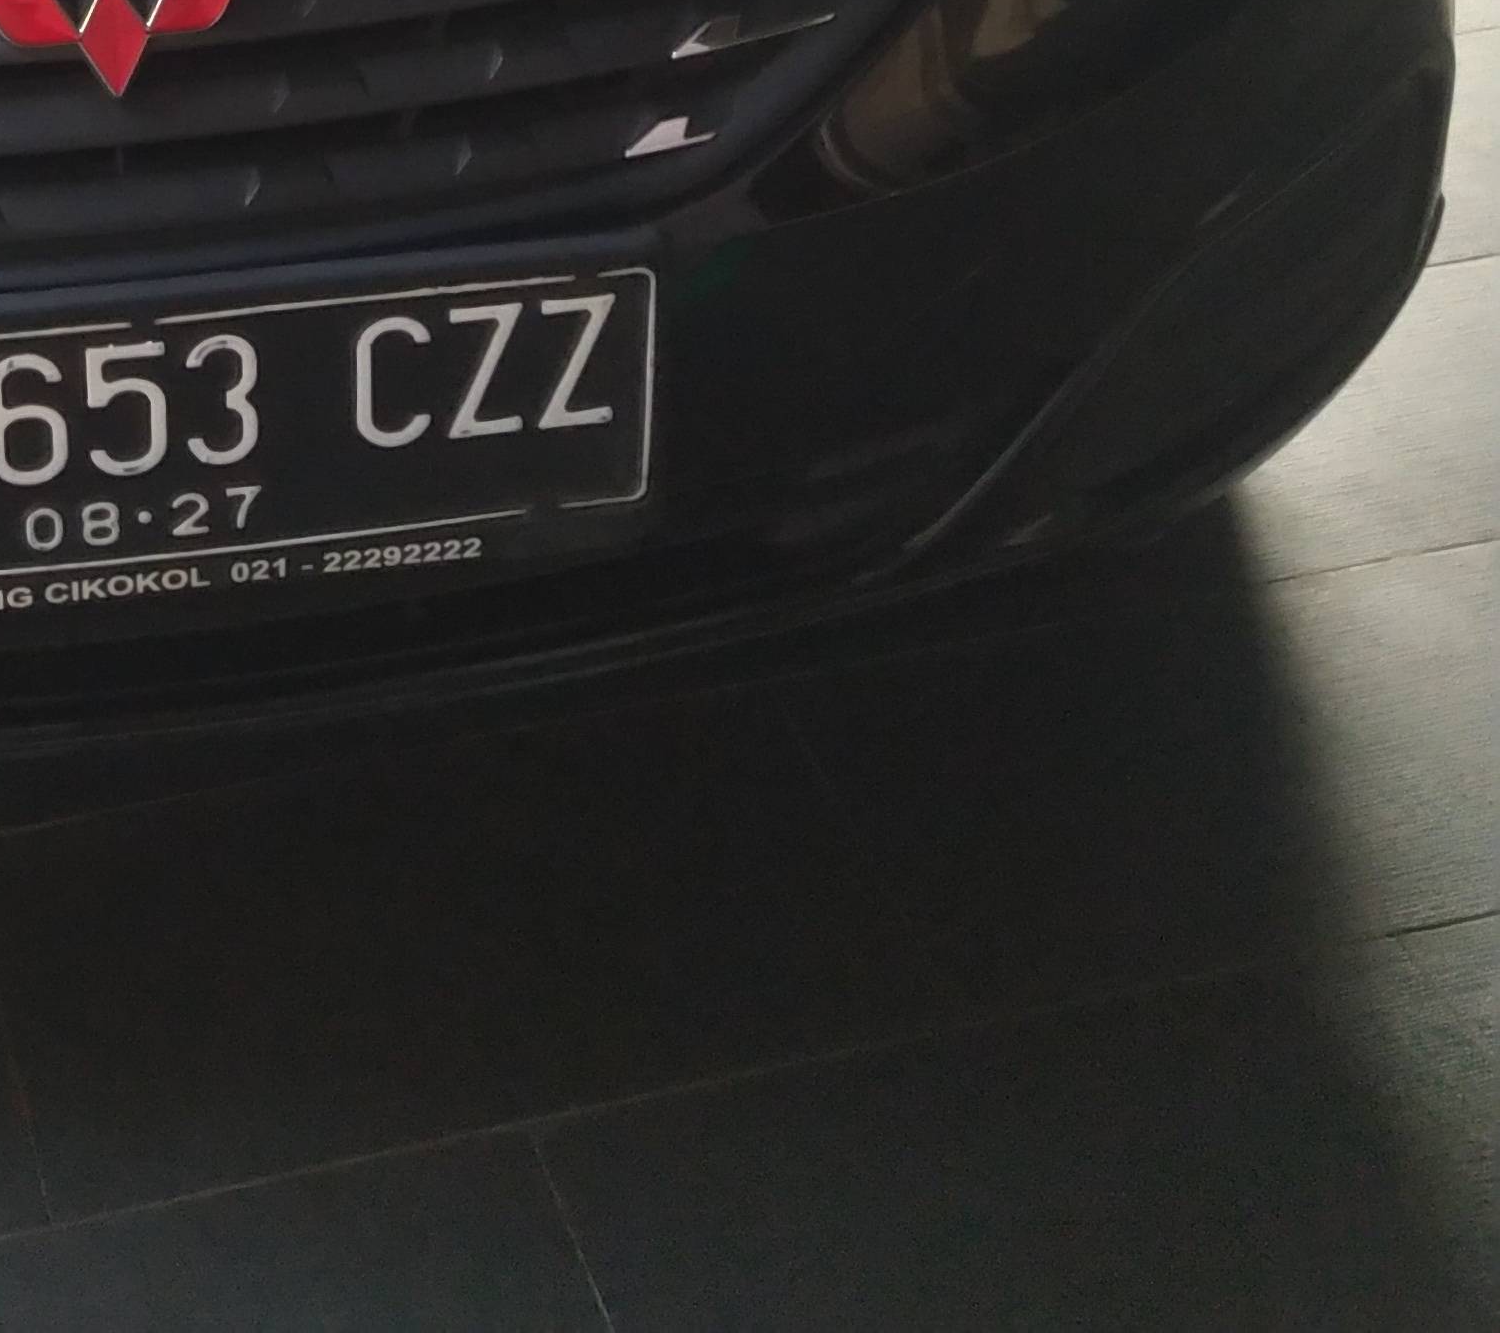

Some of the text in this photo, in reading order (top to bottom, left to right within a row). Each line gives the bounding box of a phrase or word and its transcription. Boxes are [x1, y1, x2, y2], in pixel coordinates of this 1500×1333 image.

[354, 292, 617, 449] CZZ
[44, 567, 211, 605] CIKOKOL
[230, 557, 287, 584] 021
[322, 537, 483, 574] 22292222
